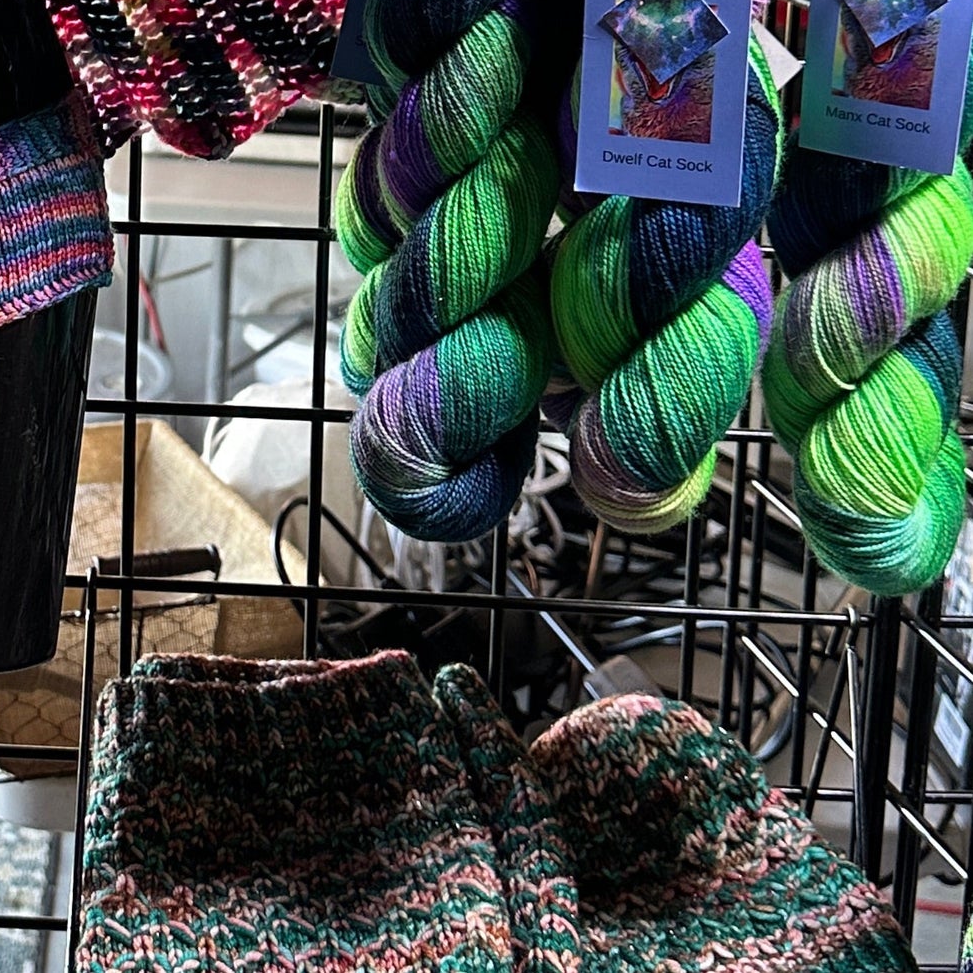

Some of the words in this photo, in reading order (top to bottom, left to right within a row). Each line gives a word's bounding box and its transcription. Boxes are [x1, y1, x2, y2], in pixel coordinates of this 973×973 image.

[825, 106, 862, 123] Manx
[866, 113, 892, 128] Cat
[895, 117, 931, 134] Sock
[602, 150, 642, 167] Dwelf
[646, 154, 672, 169] Cat
[676, 157, 713, 173] Sock
